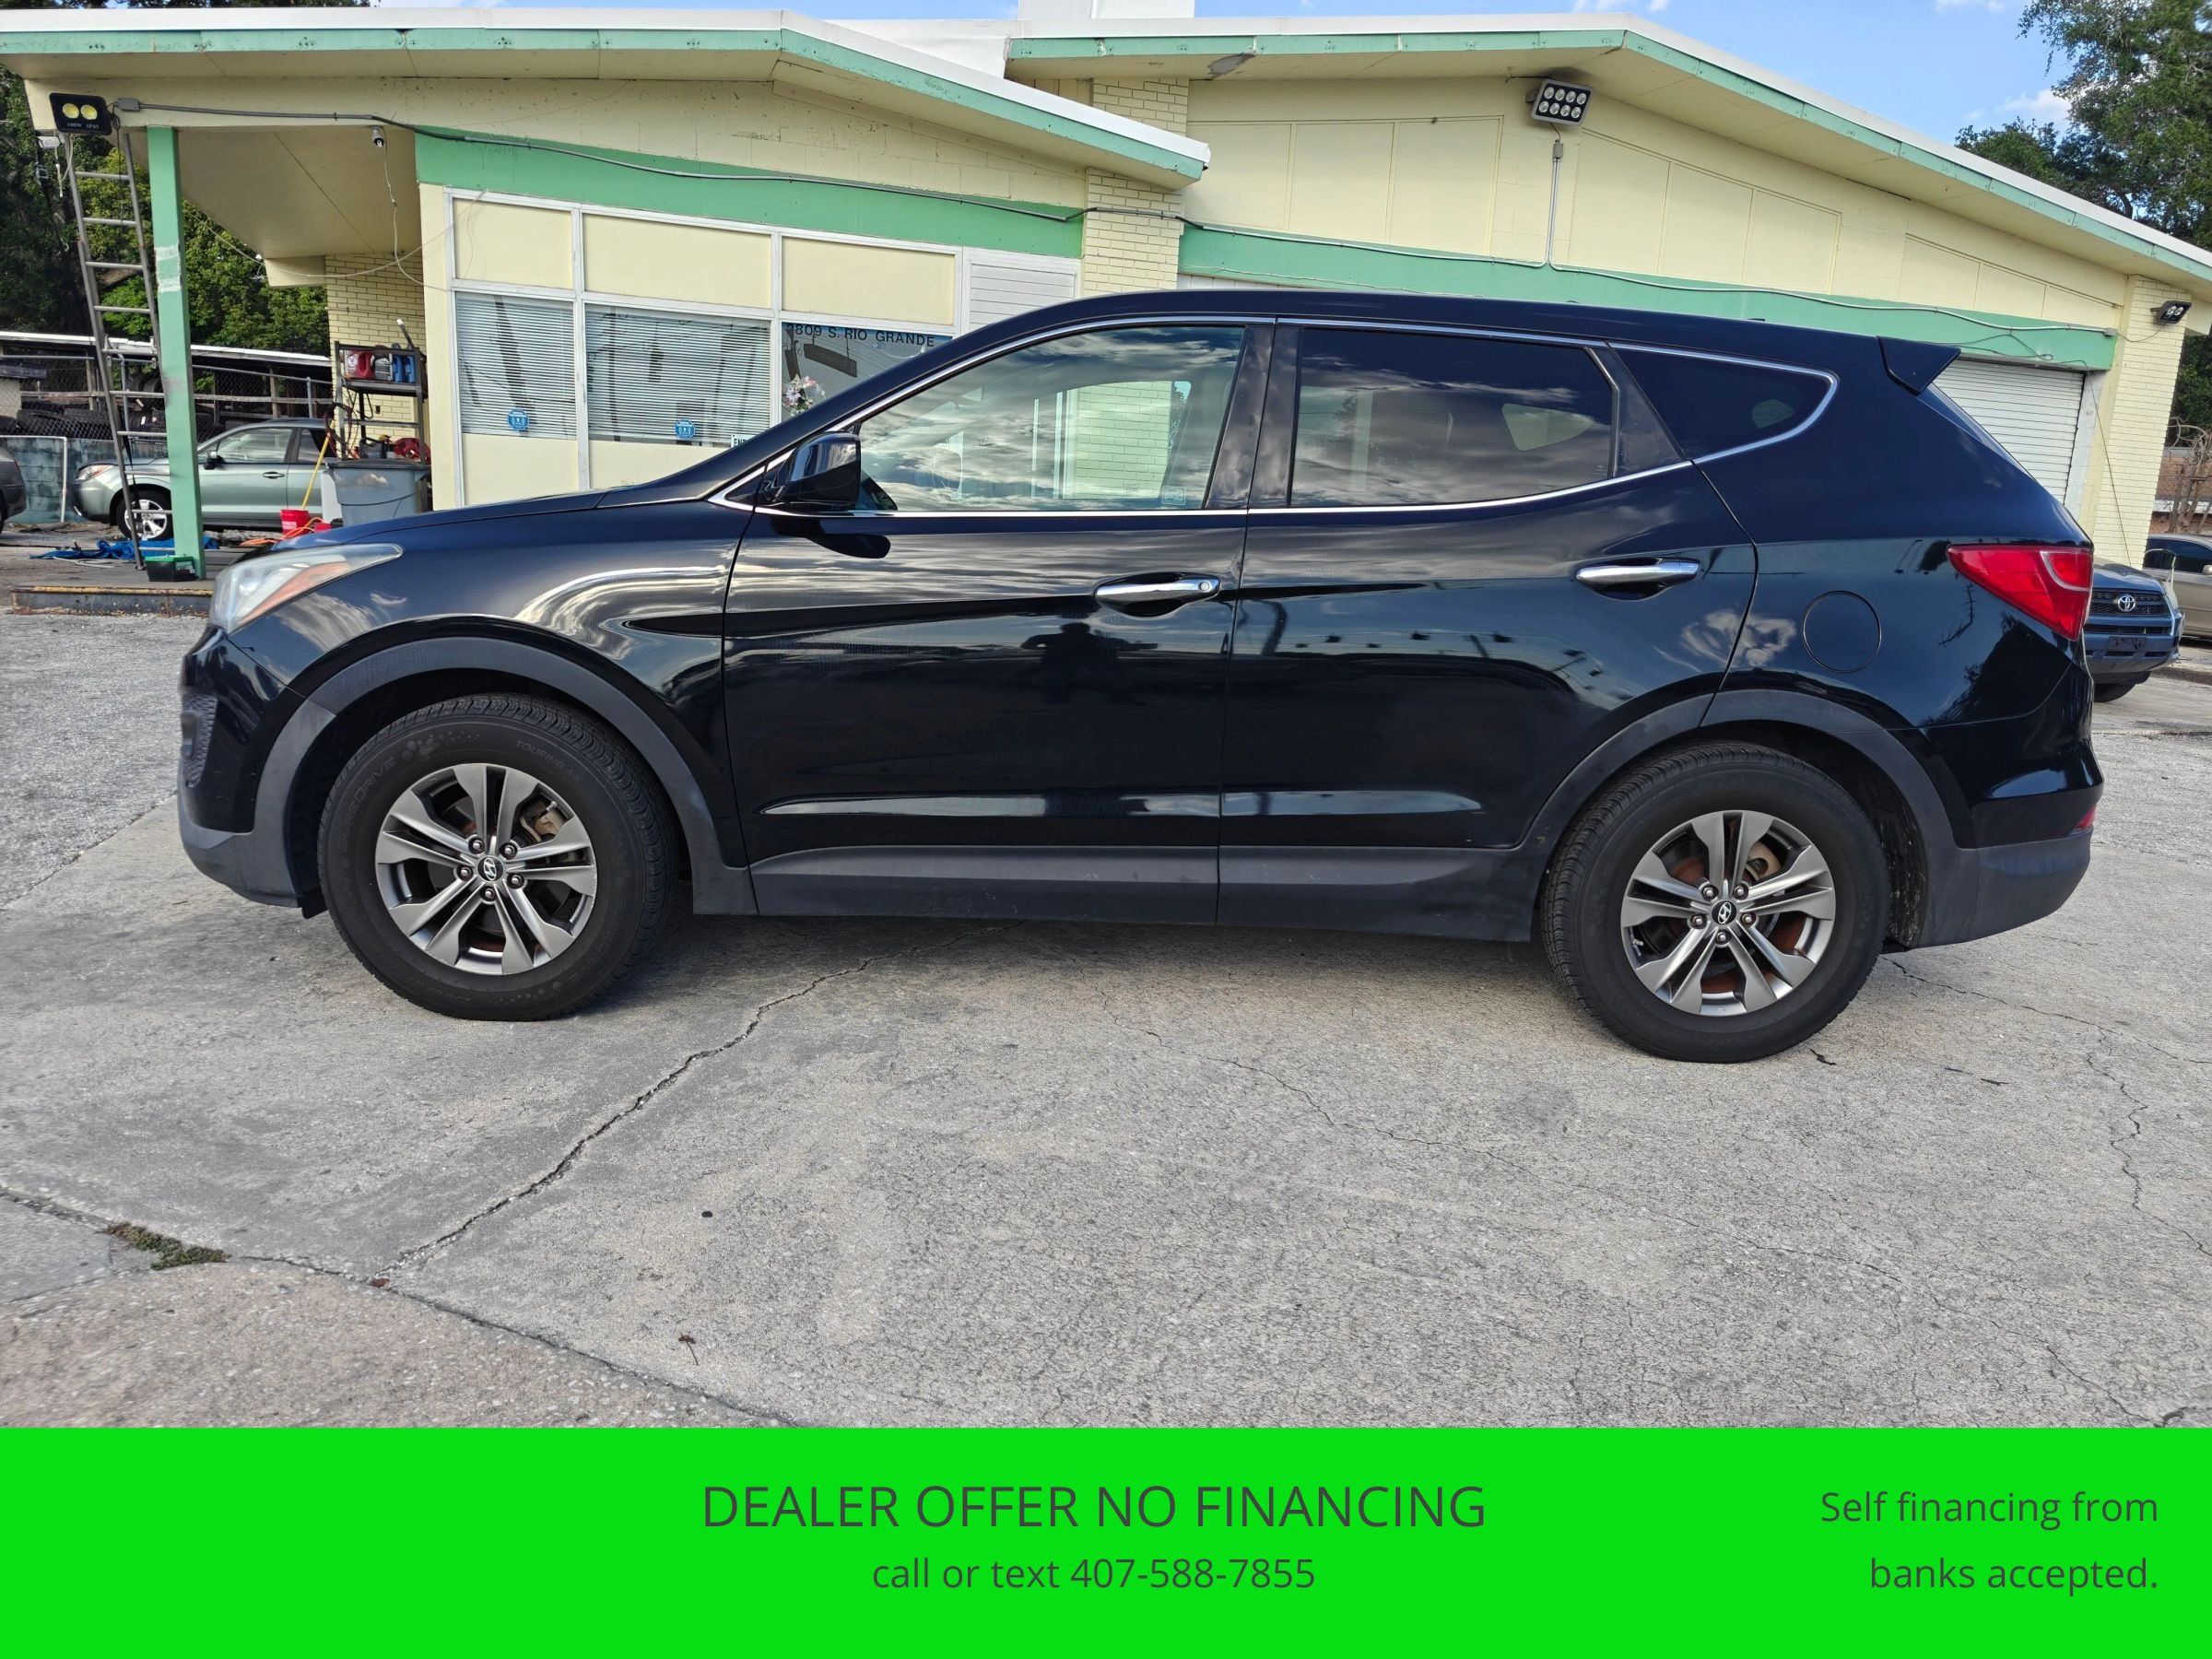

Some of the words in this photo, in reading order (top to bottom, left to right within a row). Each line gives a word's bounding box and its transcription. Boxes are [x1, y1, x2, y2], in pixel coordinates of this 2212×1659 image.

[828, 326, 840, 338] S.
[844, 328, 867, 341] RIO
[876, 332, 935, 347] GRANDE
